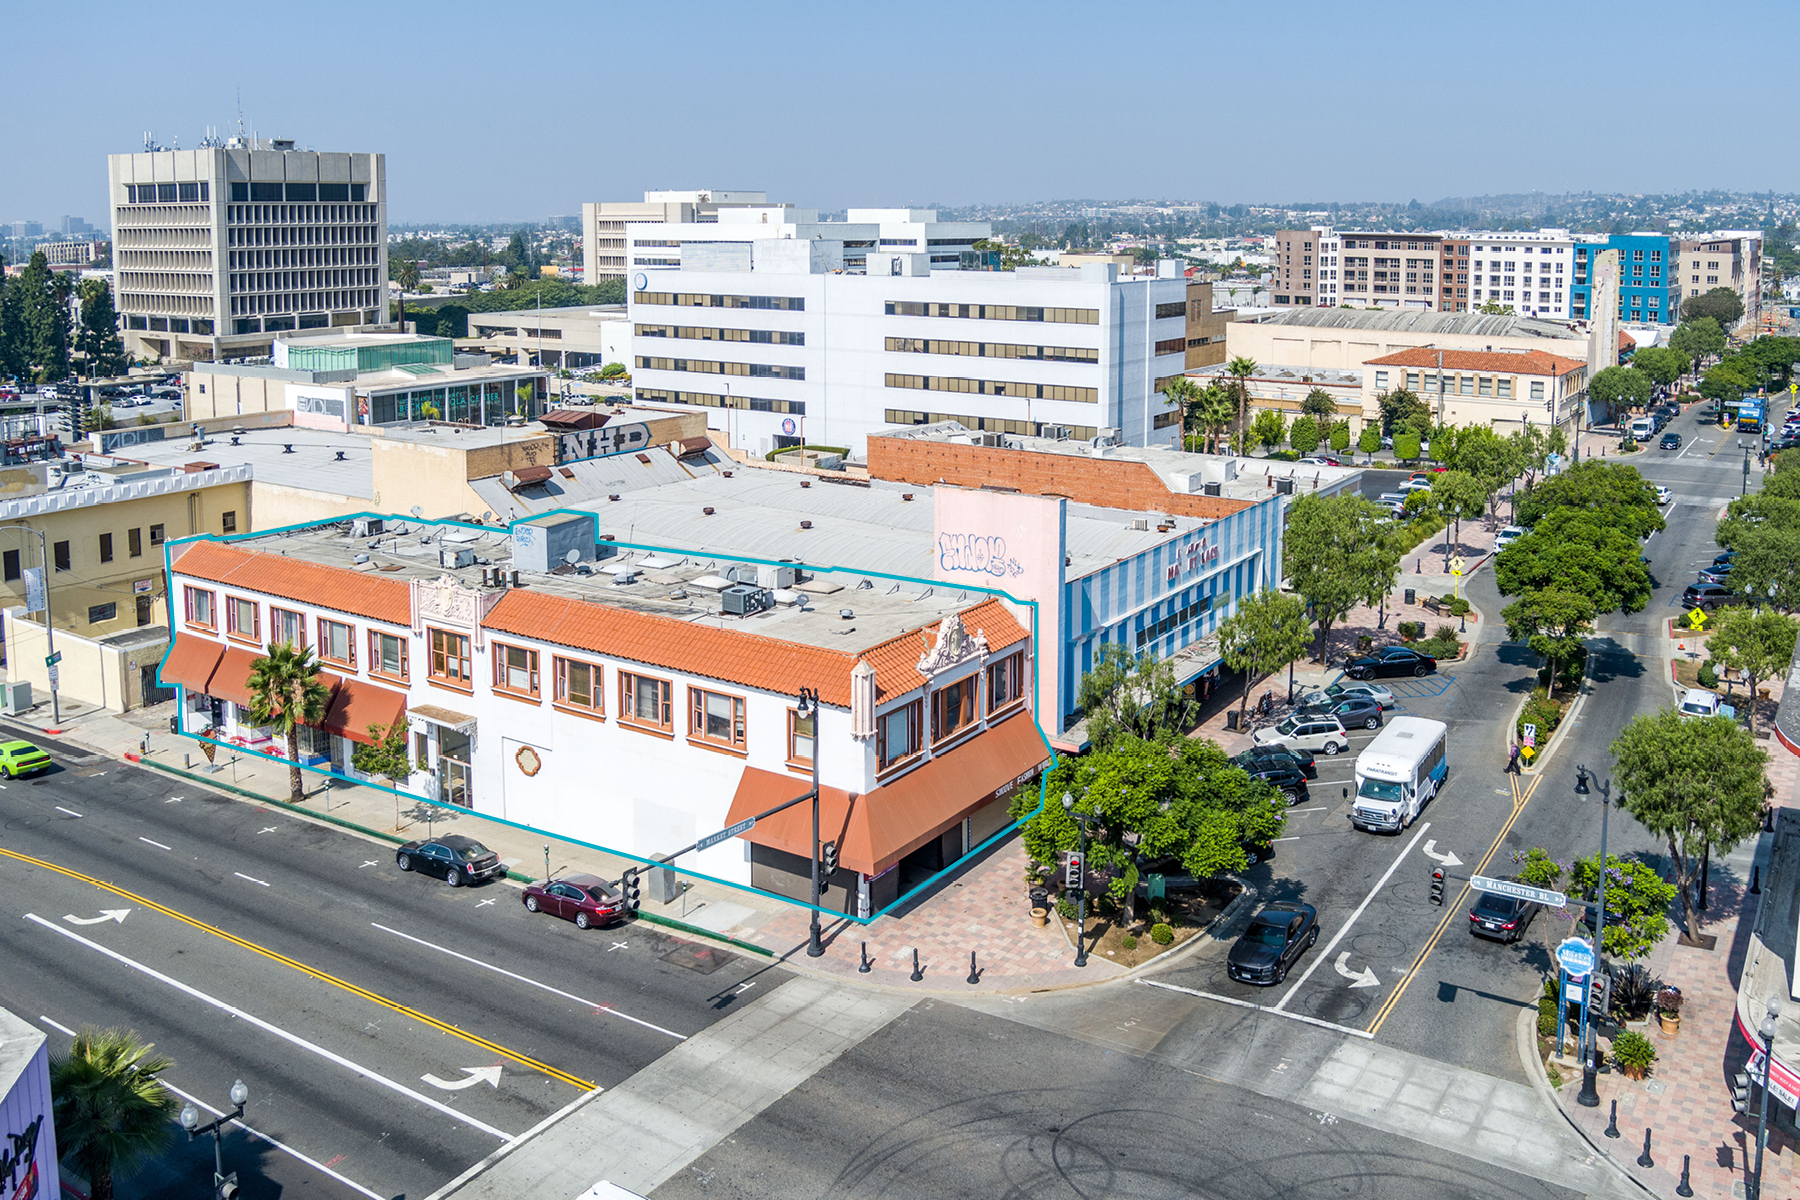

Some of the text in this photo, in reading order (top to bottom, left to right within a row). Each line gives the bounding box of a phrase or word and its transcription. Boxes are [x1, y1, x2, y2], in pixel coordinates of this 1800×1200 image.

[1366, 766, 1399, 776] PARATRANSIT
[706, 822, 746, 846] MARKET STREET
[1486, 880, 1550, 901] MANCHESTER BL
